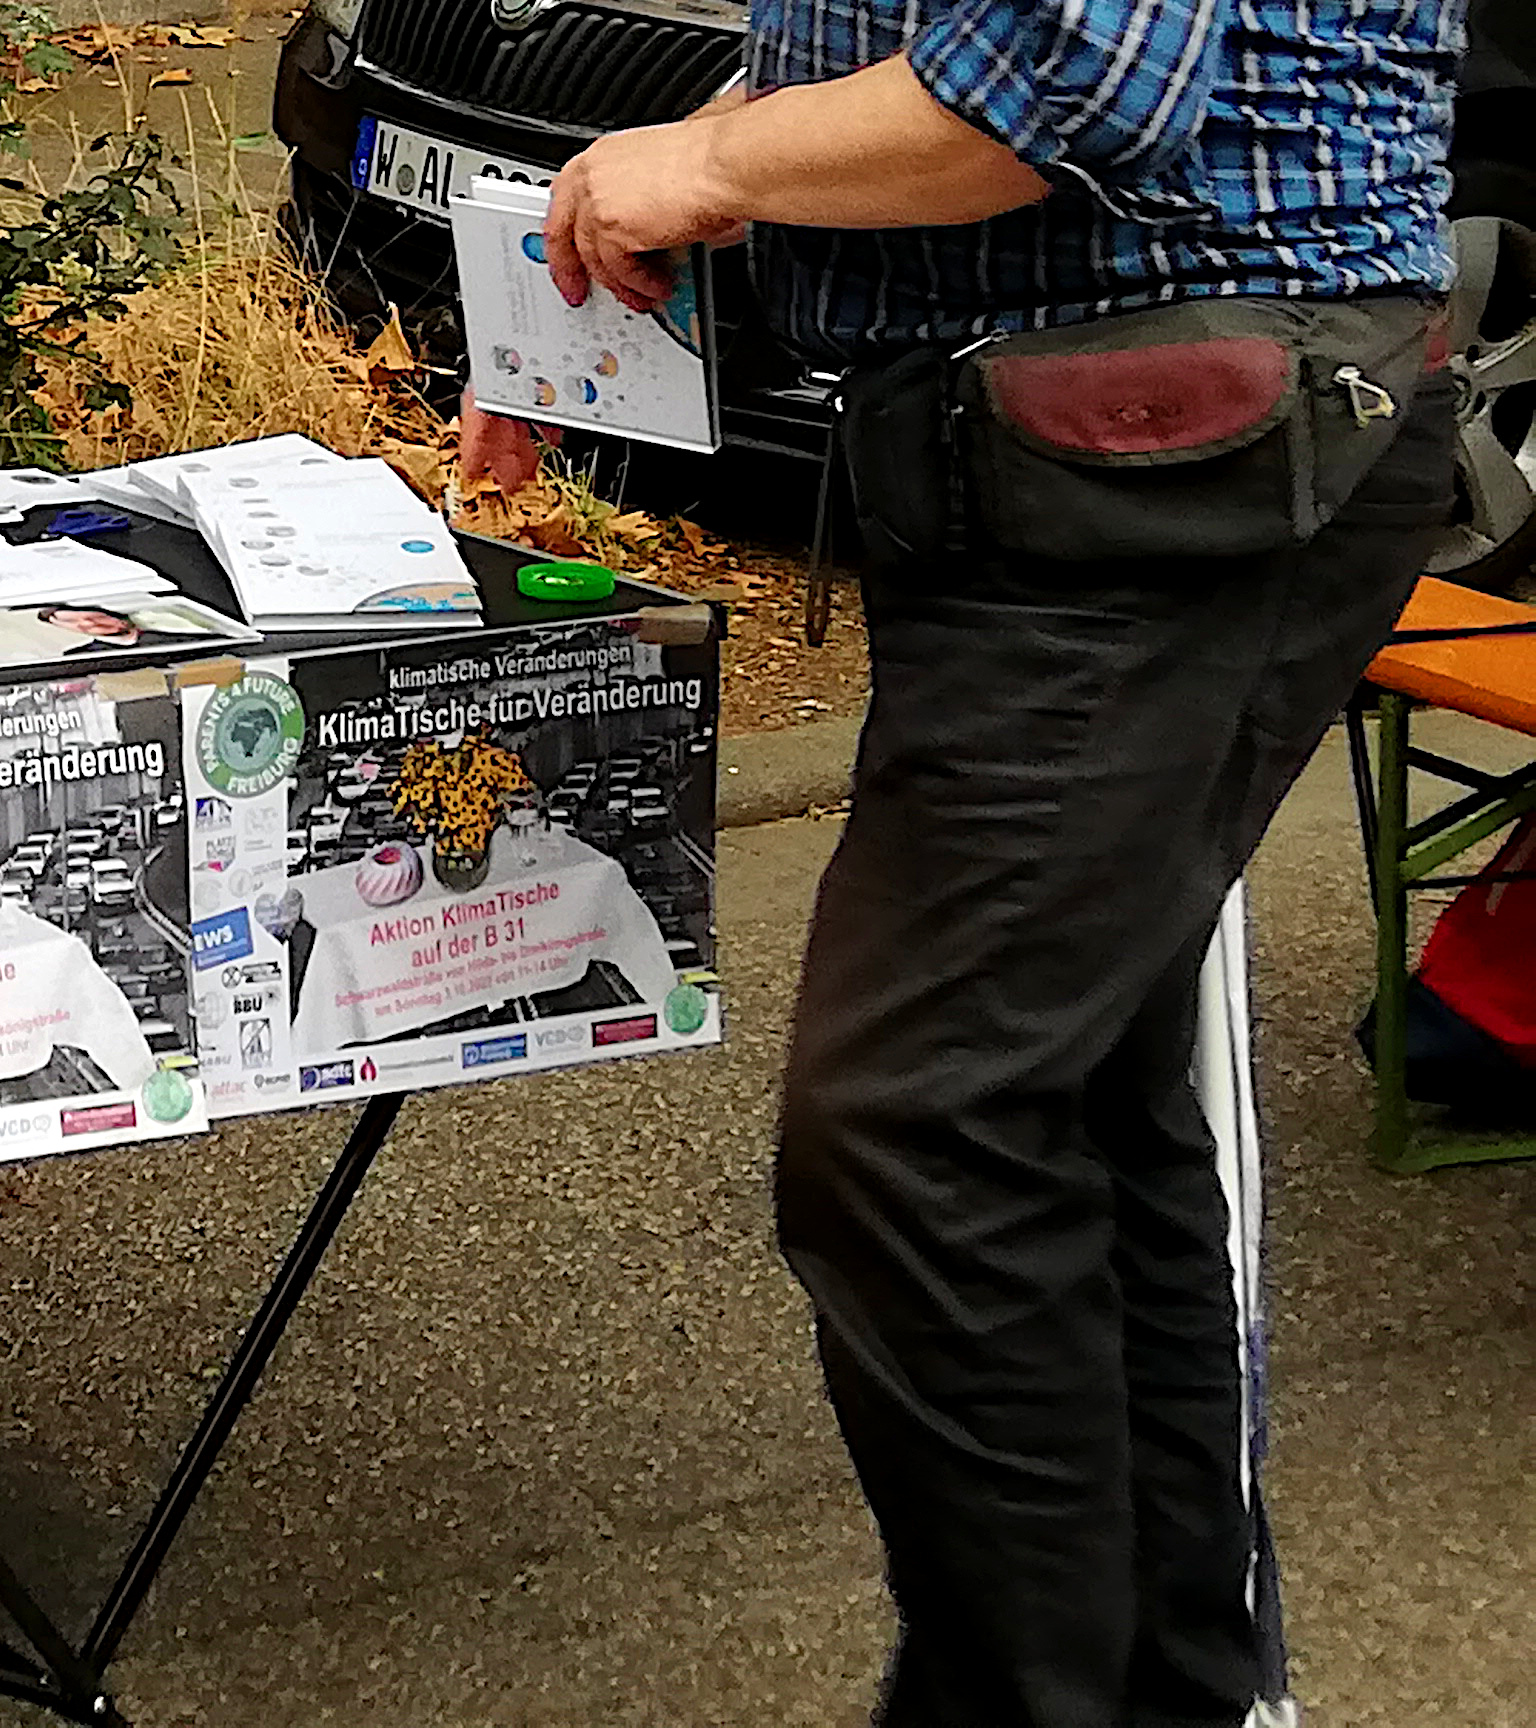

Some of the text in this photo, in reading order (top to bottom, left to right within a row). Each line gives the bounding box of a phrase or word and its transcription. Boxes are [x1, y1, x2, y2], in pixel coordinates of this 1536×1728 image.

[389, 643, 633, 690] klimatische Veränderungen
[201, 691, 231, 774] PARENTS
[242, 677, 297, 716] FUTURE
[317, 695, 481, 748] KlimaTische
[532, 678, 702, 719] Veränderung
[226, 737, 299, 795] FREIBURG
[369, 880, 561, 947] Aktion KlimaTische
[411, 916, 527, 969] auf der B 31
